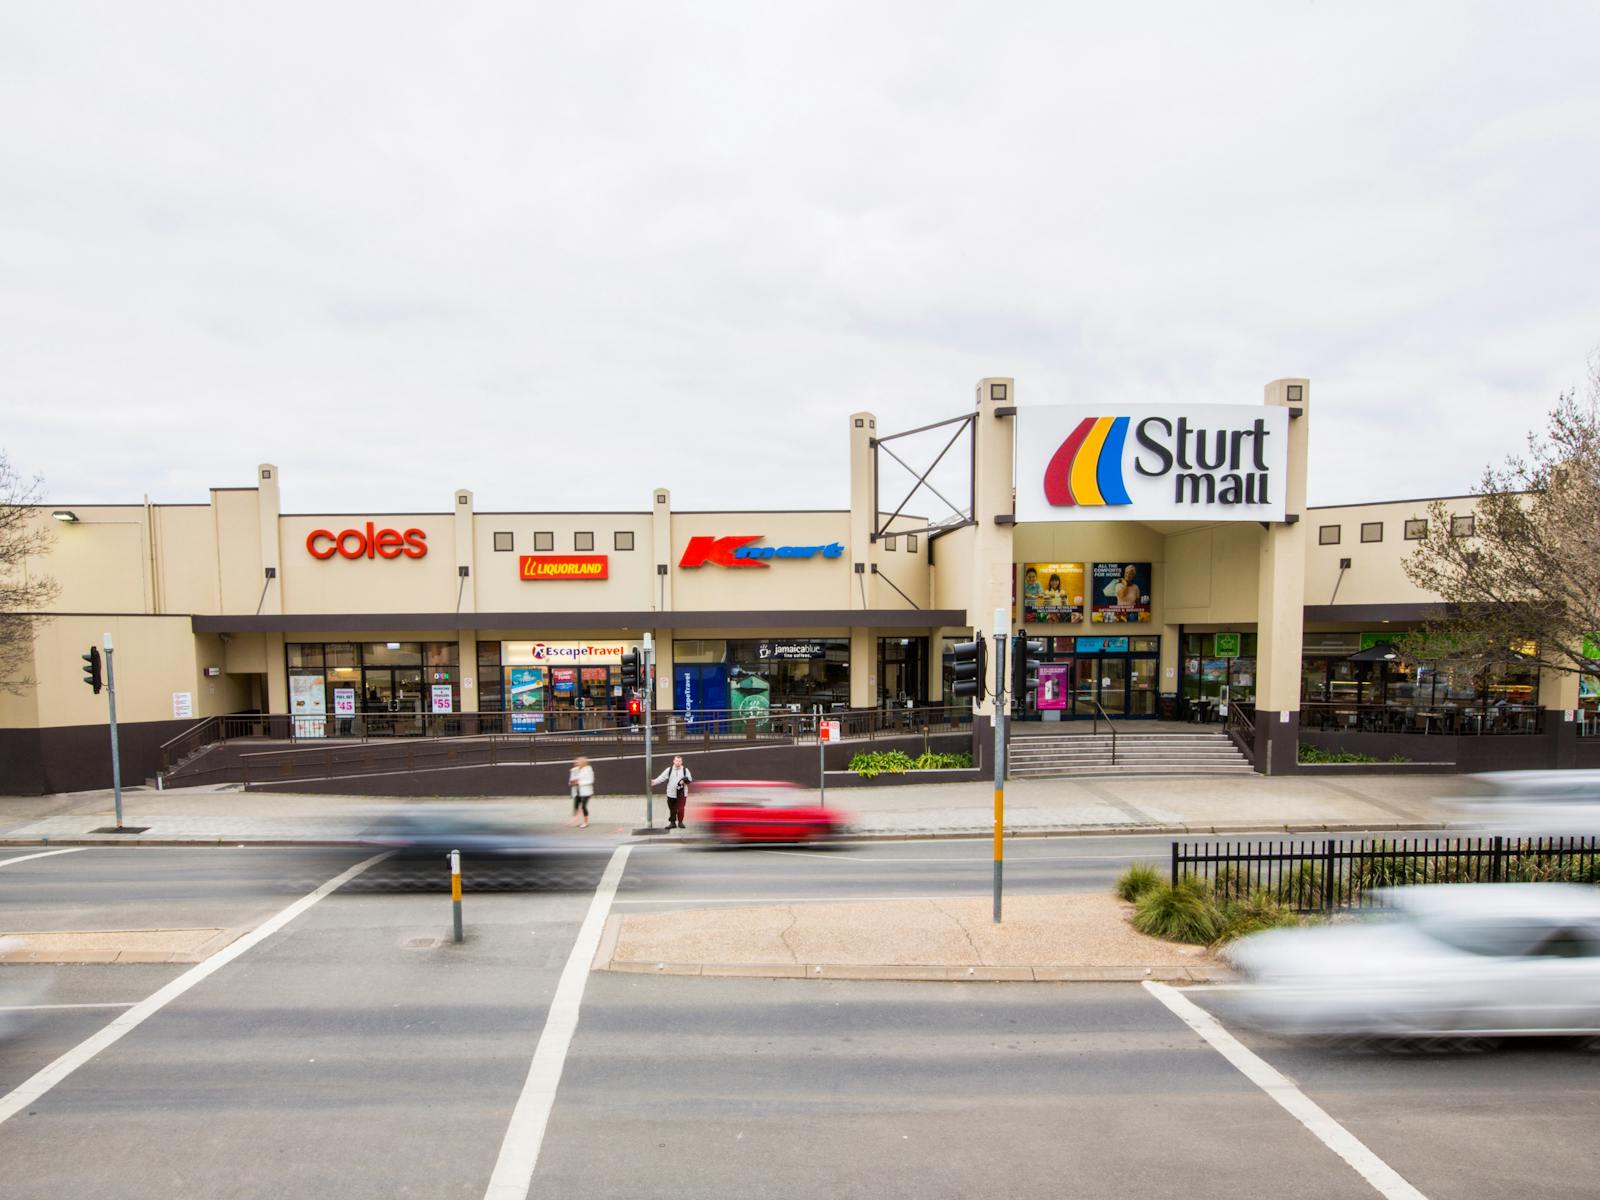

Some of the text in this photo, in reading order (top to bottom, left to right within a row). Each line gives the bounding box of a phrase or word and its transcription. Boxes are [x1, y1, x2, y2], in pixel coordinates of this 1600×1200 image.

[1135, 416, 1270, 477] Sturt
[1175, 473, 1272, 505] mall
[306, 521, 428, 560] coles
[679, 535, 844, 568] Kmart
[537, 563, 602, 576] LIQUORLAND
[546, 646, 625, 659] EscapeTravel
[774, 644, 821, 655] jamaicablue
[337, 701, 353, 711] $45
[434, 699, 450, 708] $55
